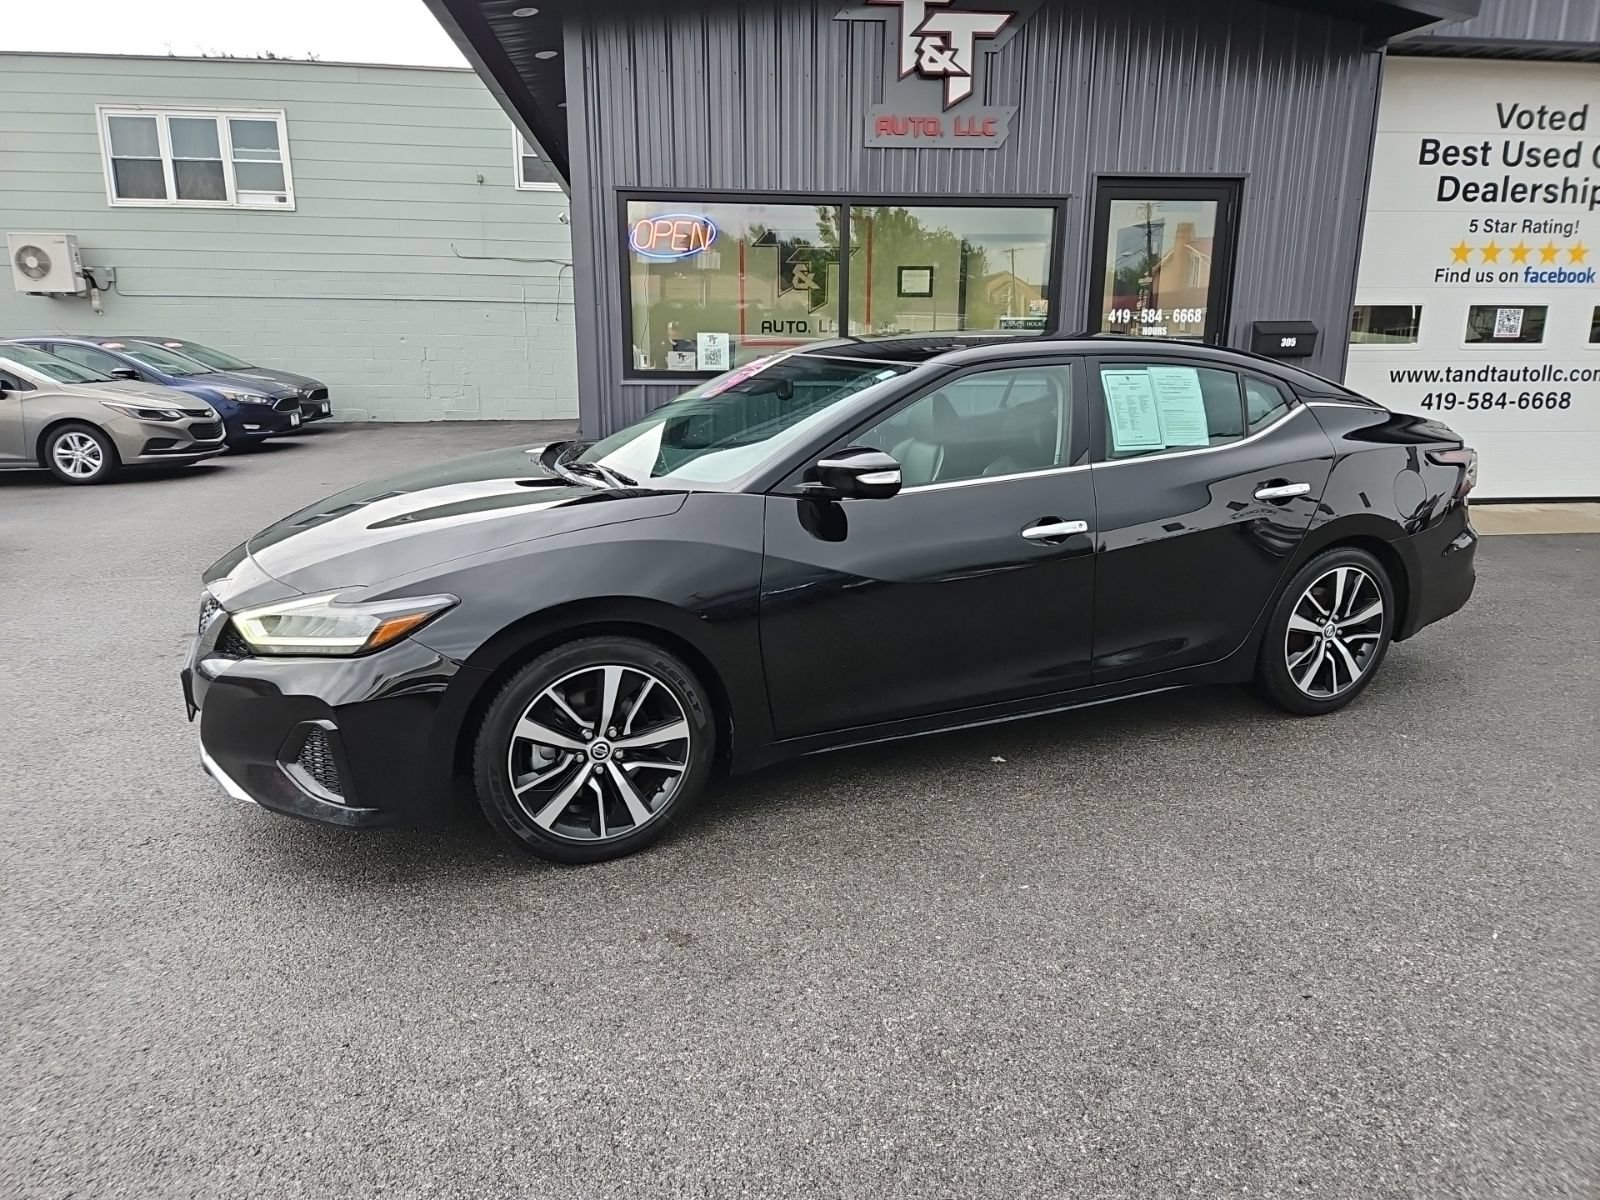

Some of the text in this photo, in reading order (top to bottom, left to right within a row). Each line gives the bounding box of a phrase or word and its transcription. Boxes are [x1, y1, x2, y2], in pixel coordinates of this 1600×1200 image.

[954, 115, 998, 137] LLC
[1496, 102, 1589, 131] Voted
[1418, 138, 1492, 167] Best
[1502, 140, 1583, 169] Used
[1436, 175, 1600, 211] Dealership
[633, 219, 711, 251] OPEN
[1469, 218, 1580, 238] 5 Star Rating!
[1434, 266, 1596, 284] Find us on facebook
[1280, 337, 1297, 348] 305
[1390, 364, 1600, 383] www.tandtautollc.co
[1420, 391, 1572, 411] 419-584-6668
[654, 661, 702, 713] KELLY
